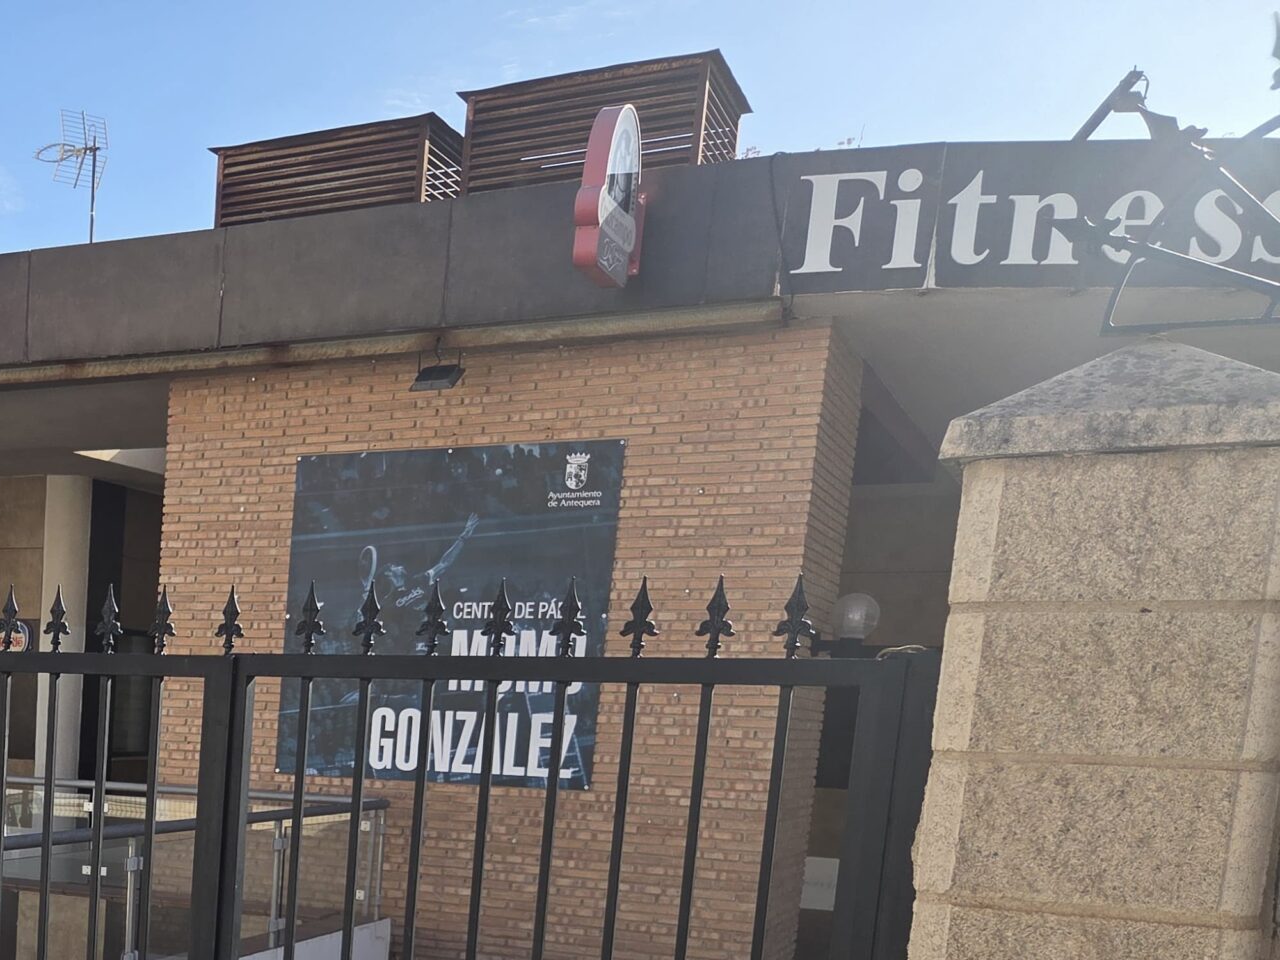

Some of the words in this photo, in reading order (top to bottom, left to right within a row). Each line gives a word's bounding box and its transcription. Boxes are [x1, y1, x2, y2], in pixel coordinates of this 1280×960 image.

[547, 491, 602, 500] Ayuntamiento
[547, 499, 558, 507] de
[560, 499, 601, 507] Antequera
[453, 602, 511, 619] CENT
[514, 602, 535, 619] DE
[538, 598, 586, 619] PÁL
